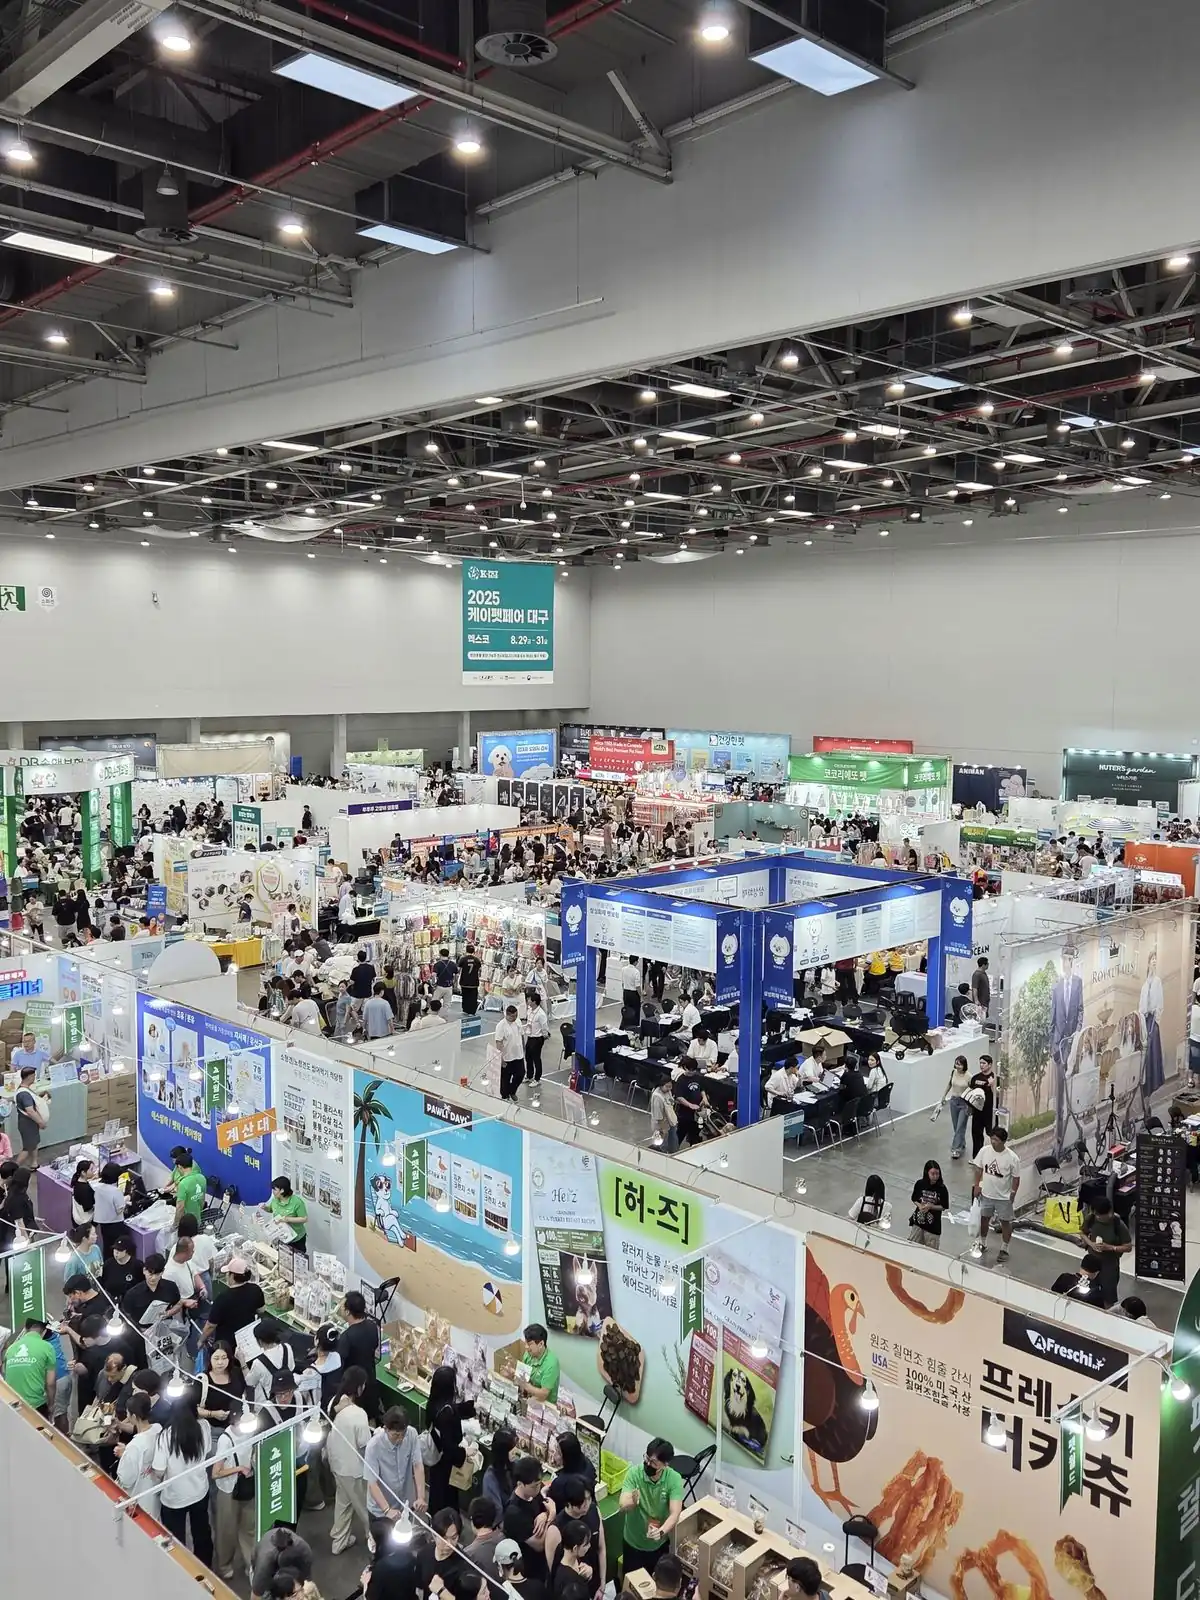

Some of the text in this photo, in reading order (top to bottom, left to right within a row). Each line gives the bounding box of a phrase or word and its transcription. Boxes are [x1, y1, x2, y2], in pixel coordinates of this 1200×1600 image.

[468, 590, 500, 605] 2025
[468, 607, 549, 624] 케이펫페어 대구
[468, 634, 490, 644] 엑스코
[468, 964, 473, 974] 7
[226, 1116, 270, 1142] 계산대
[411, 1160, 420, 1190] 펫월드
[622, 1241, 643, 1261] 알러지
[646, 1252, 661, 1267] 눈물
[626, 1260, 648, 1280] 뛰어난
[22, 1276, 34, 1313] 펫월드
[622, 1274, 677, 1308] 에어드라이 사료
[870, 1333, 971, 1388] 원조 칠면조 힘줄 간식
[872, 1352, 888, 1368] USA
[906, 1368, 934, 1387] 100%
[270, 1461, 282, 1514] 펫월드
